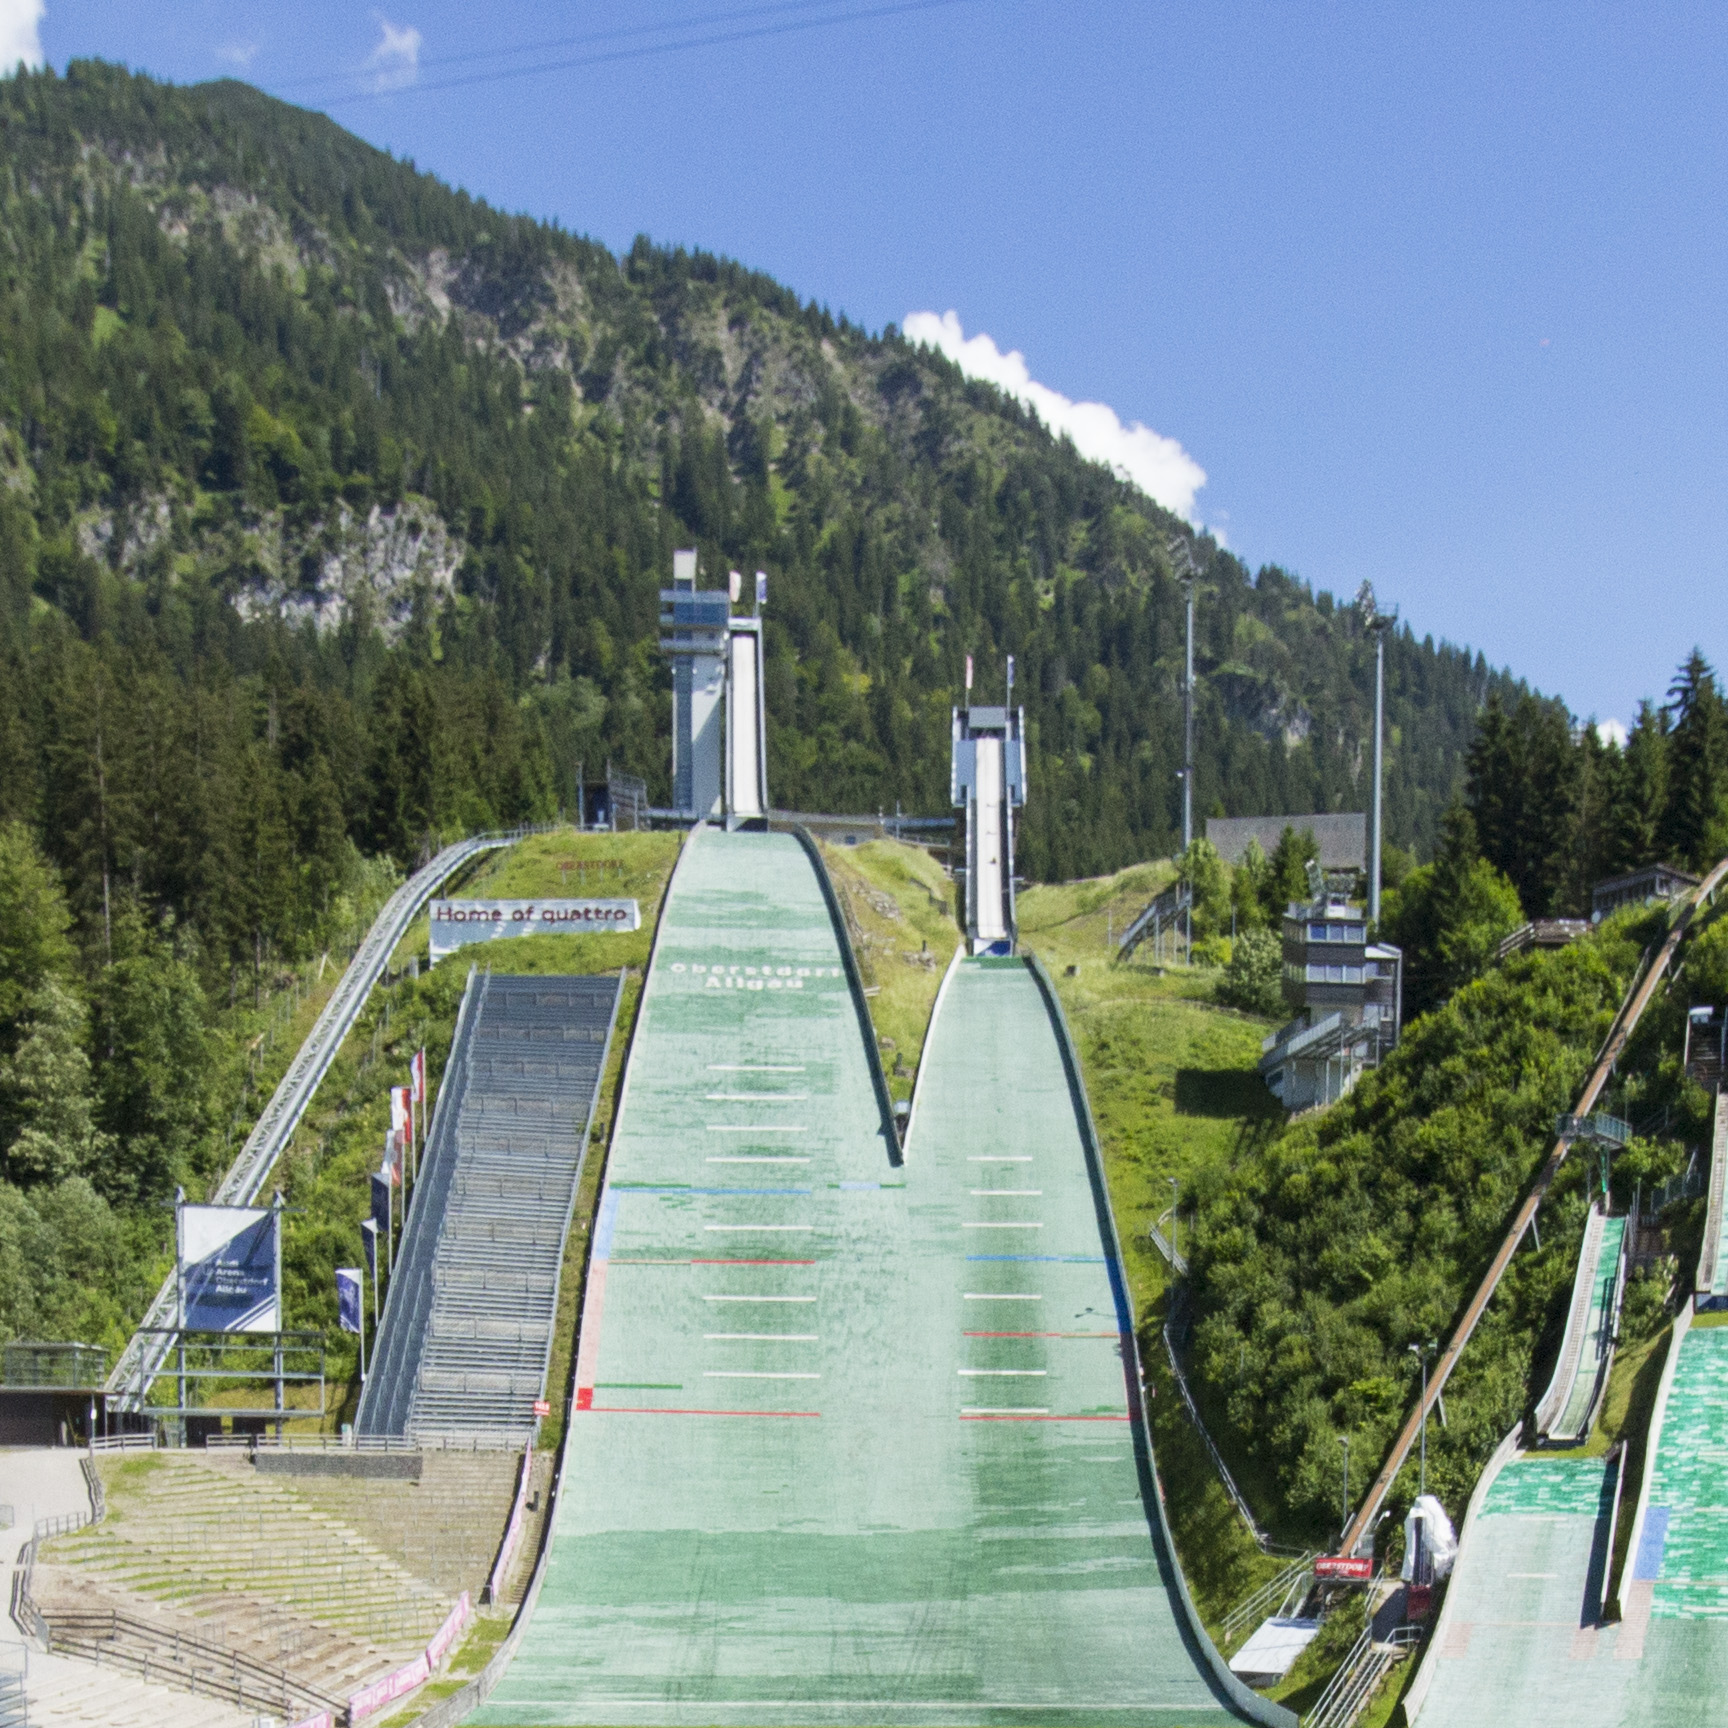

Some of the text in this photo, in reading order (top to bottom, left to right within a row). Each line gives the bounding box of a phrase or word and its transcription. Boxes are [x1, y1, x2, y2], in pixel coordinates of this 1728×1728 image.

[436, 906, 627, 924] Home of quattro
